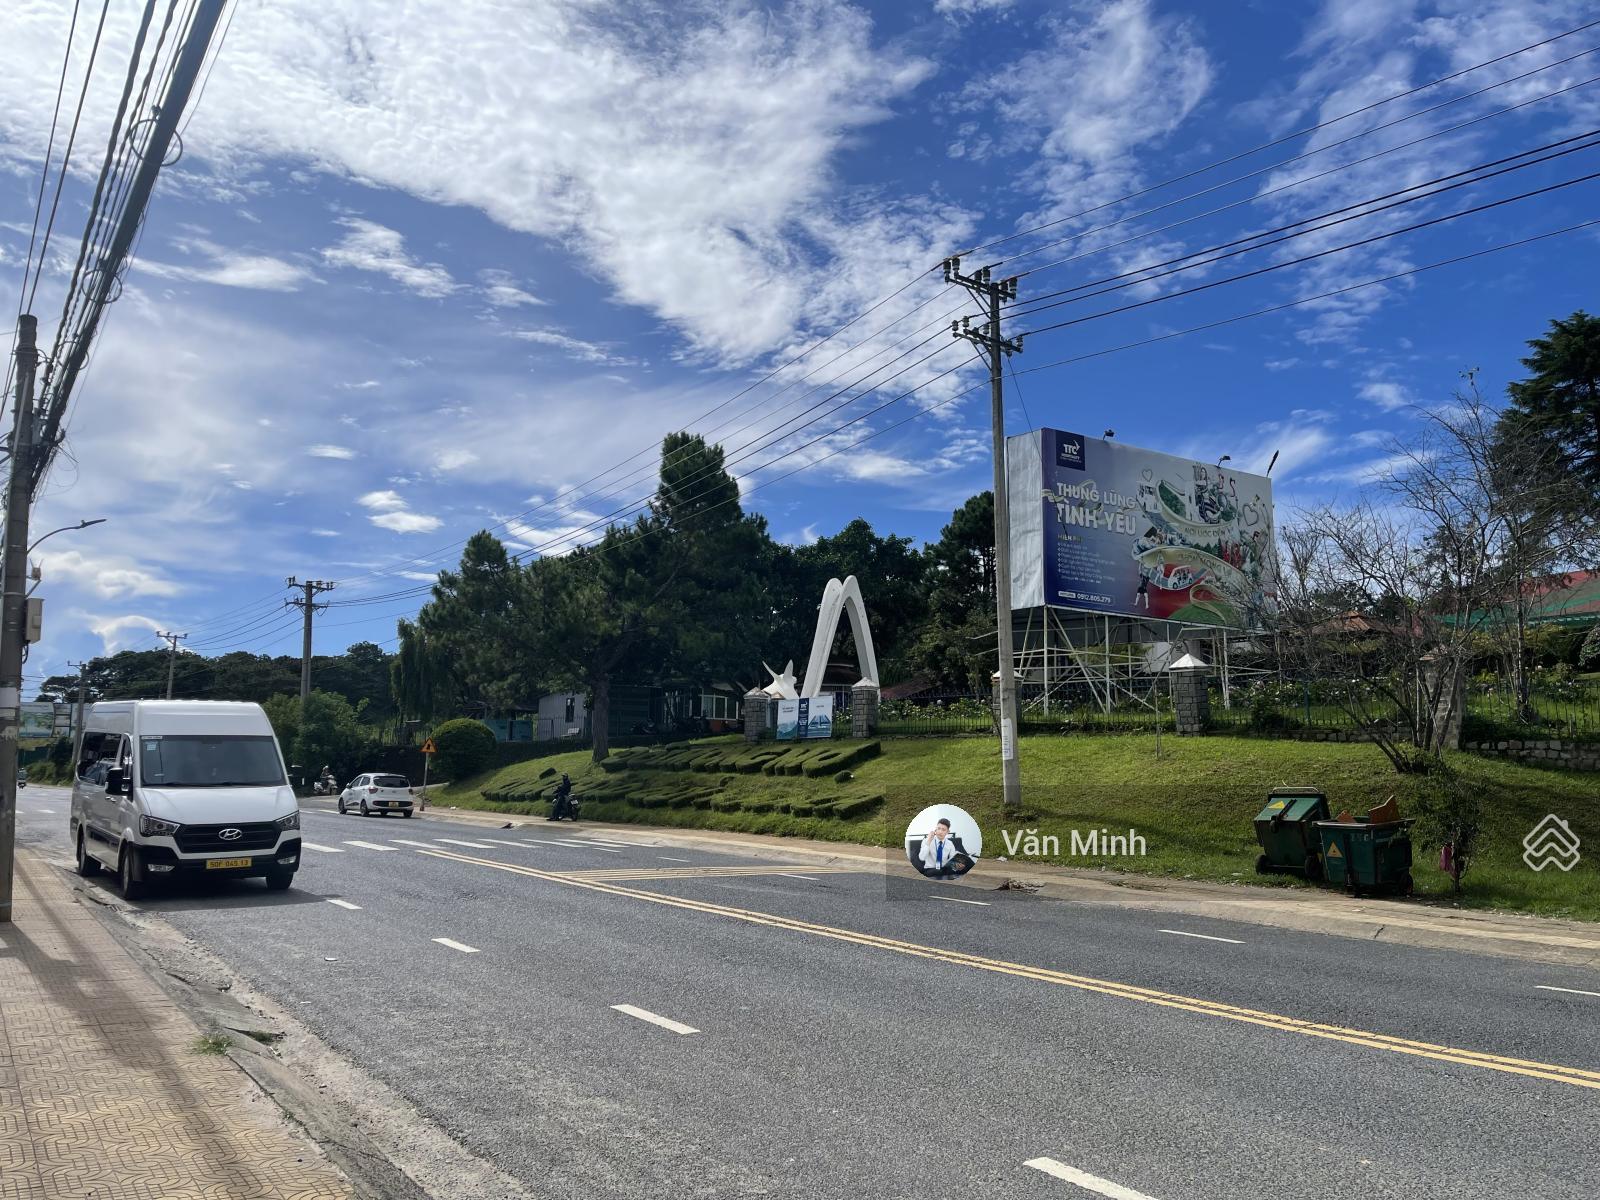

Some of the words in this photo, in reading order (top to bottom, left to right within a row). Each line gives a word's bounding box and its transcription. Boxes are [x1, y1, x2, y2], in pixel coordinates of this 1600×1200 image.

[1063, 442, 1080, 455] TTC
[1056, 482, 1100, 503] THUNG
[1103, 489, 1136, 509] LŨNG
[1056, 499, 1098, 529] TÌNH
[1104, 509, 1136, 536] YÊU
